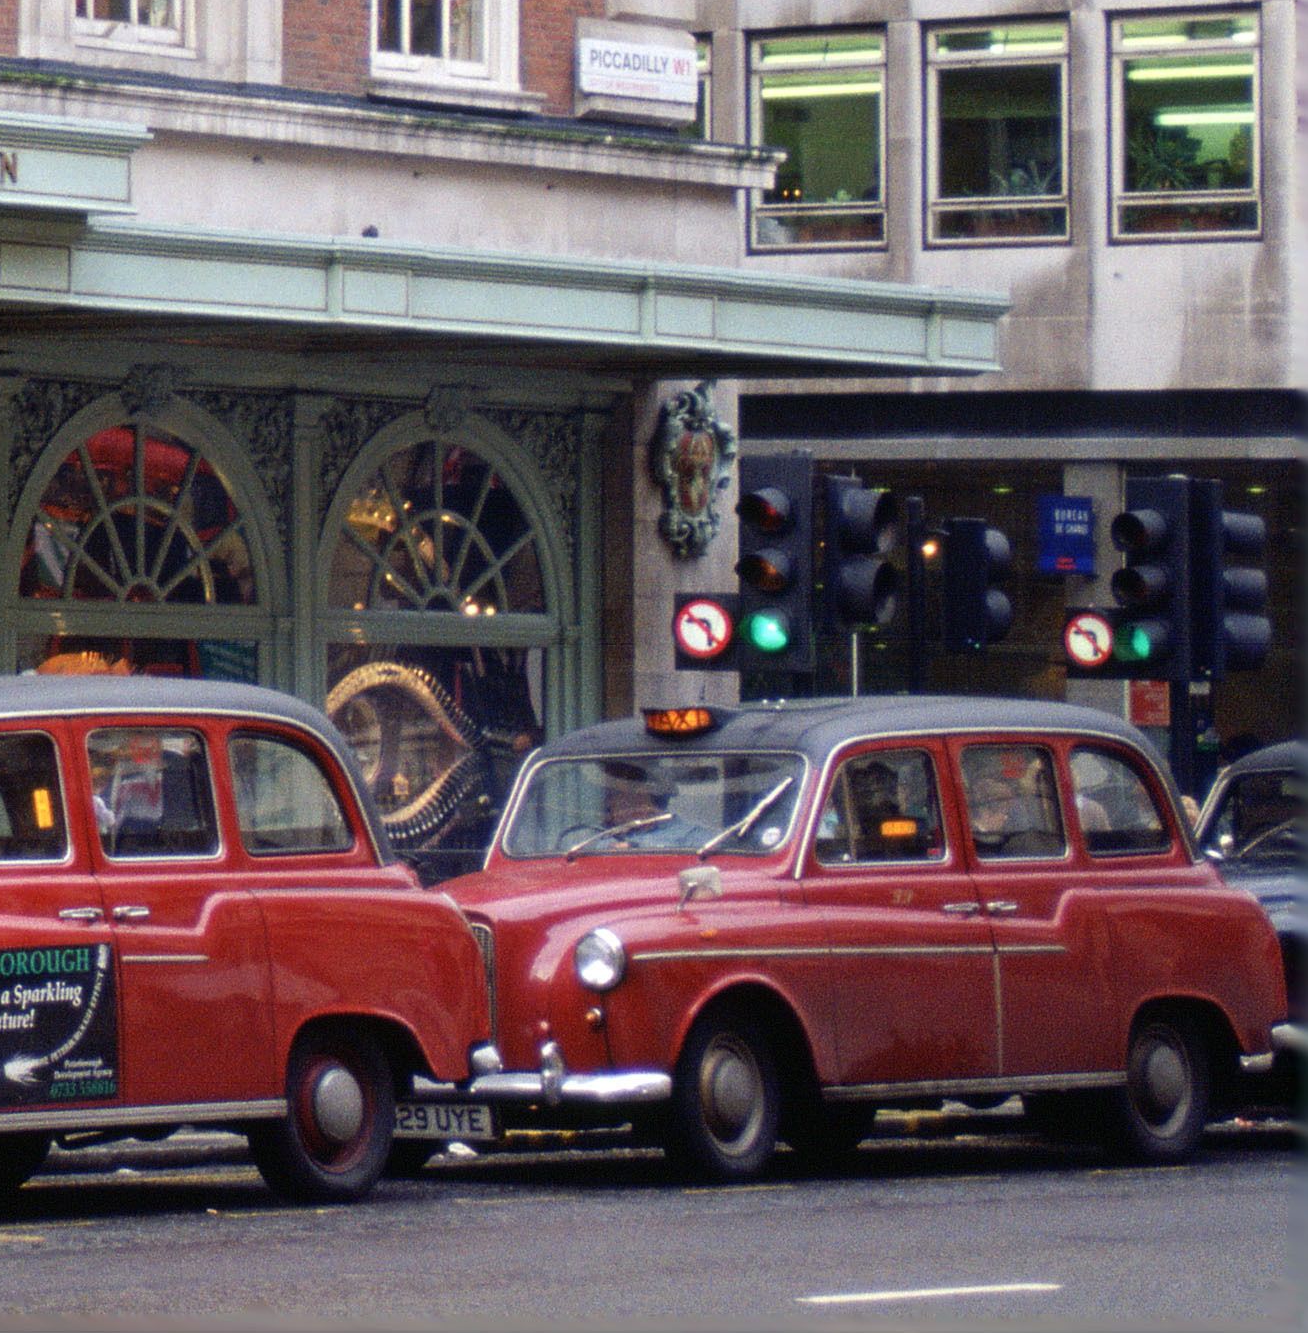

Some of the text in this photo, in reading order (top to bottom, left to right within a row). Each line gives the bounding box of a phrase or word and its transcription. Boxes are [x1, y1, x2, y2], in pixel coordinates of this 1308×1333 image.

[589, 49, 691, 75] PICCADILLY W1
[1, 990, 11, 1005] a
[13, 982, 83, 1010] Sparkling
[393, 1106, 484, 1132] 29 UYE
